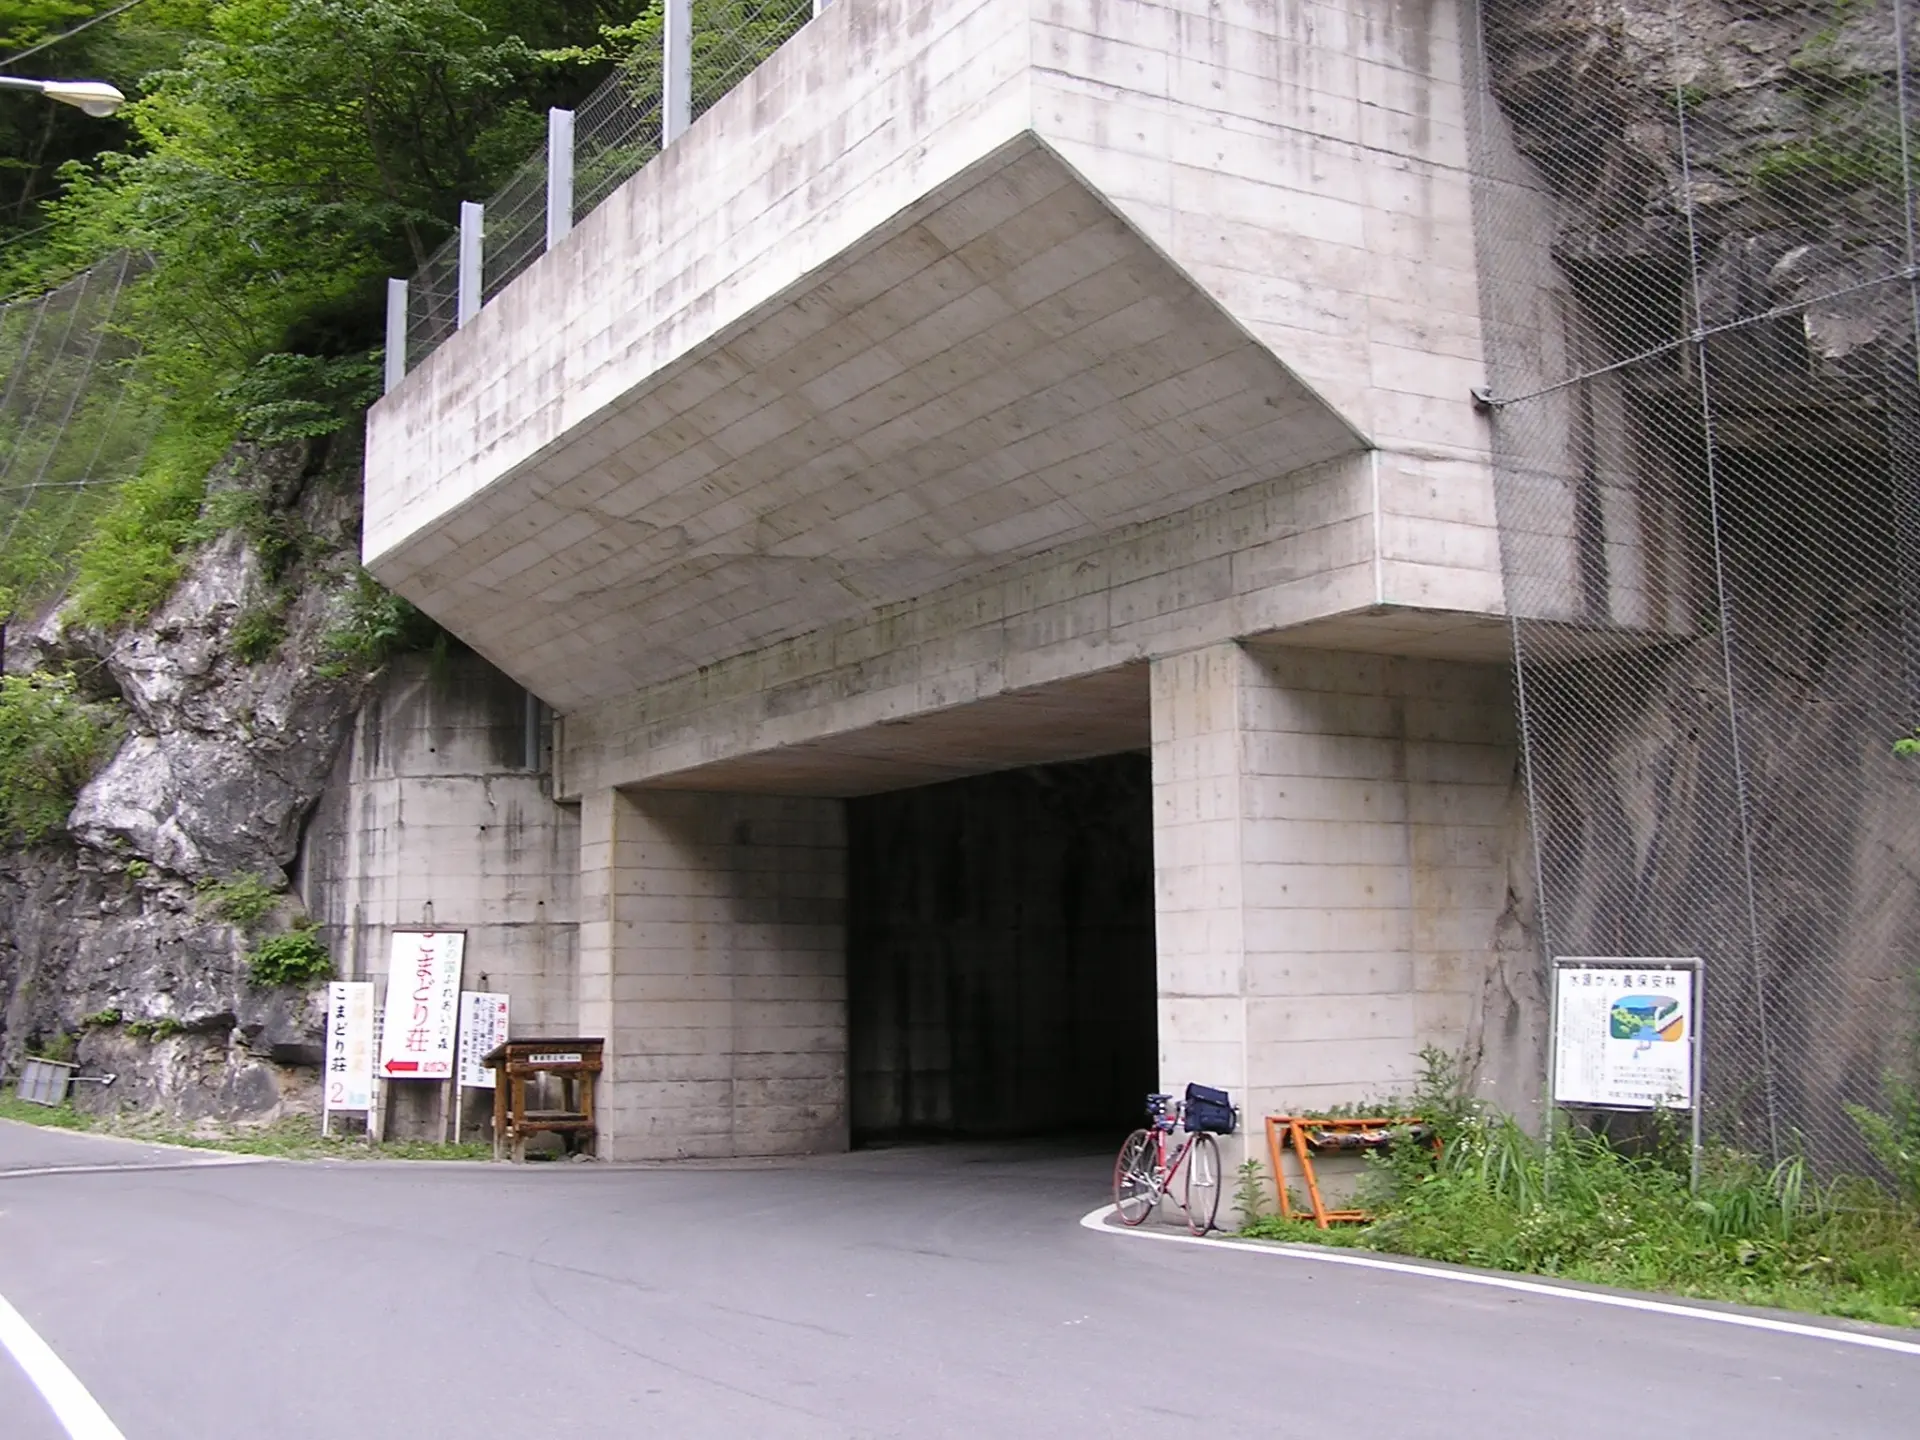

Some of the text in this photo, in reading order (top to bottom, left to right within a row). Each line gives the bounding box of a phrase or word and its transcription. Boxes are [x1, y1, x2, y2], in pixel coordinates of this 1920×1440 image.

[405, 933, 435, 1052] こまどり荘
[1569, 973, 1677, 988] 水源かん養保安林
[330, 987, 348, 1073] こまどり荘
